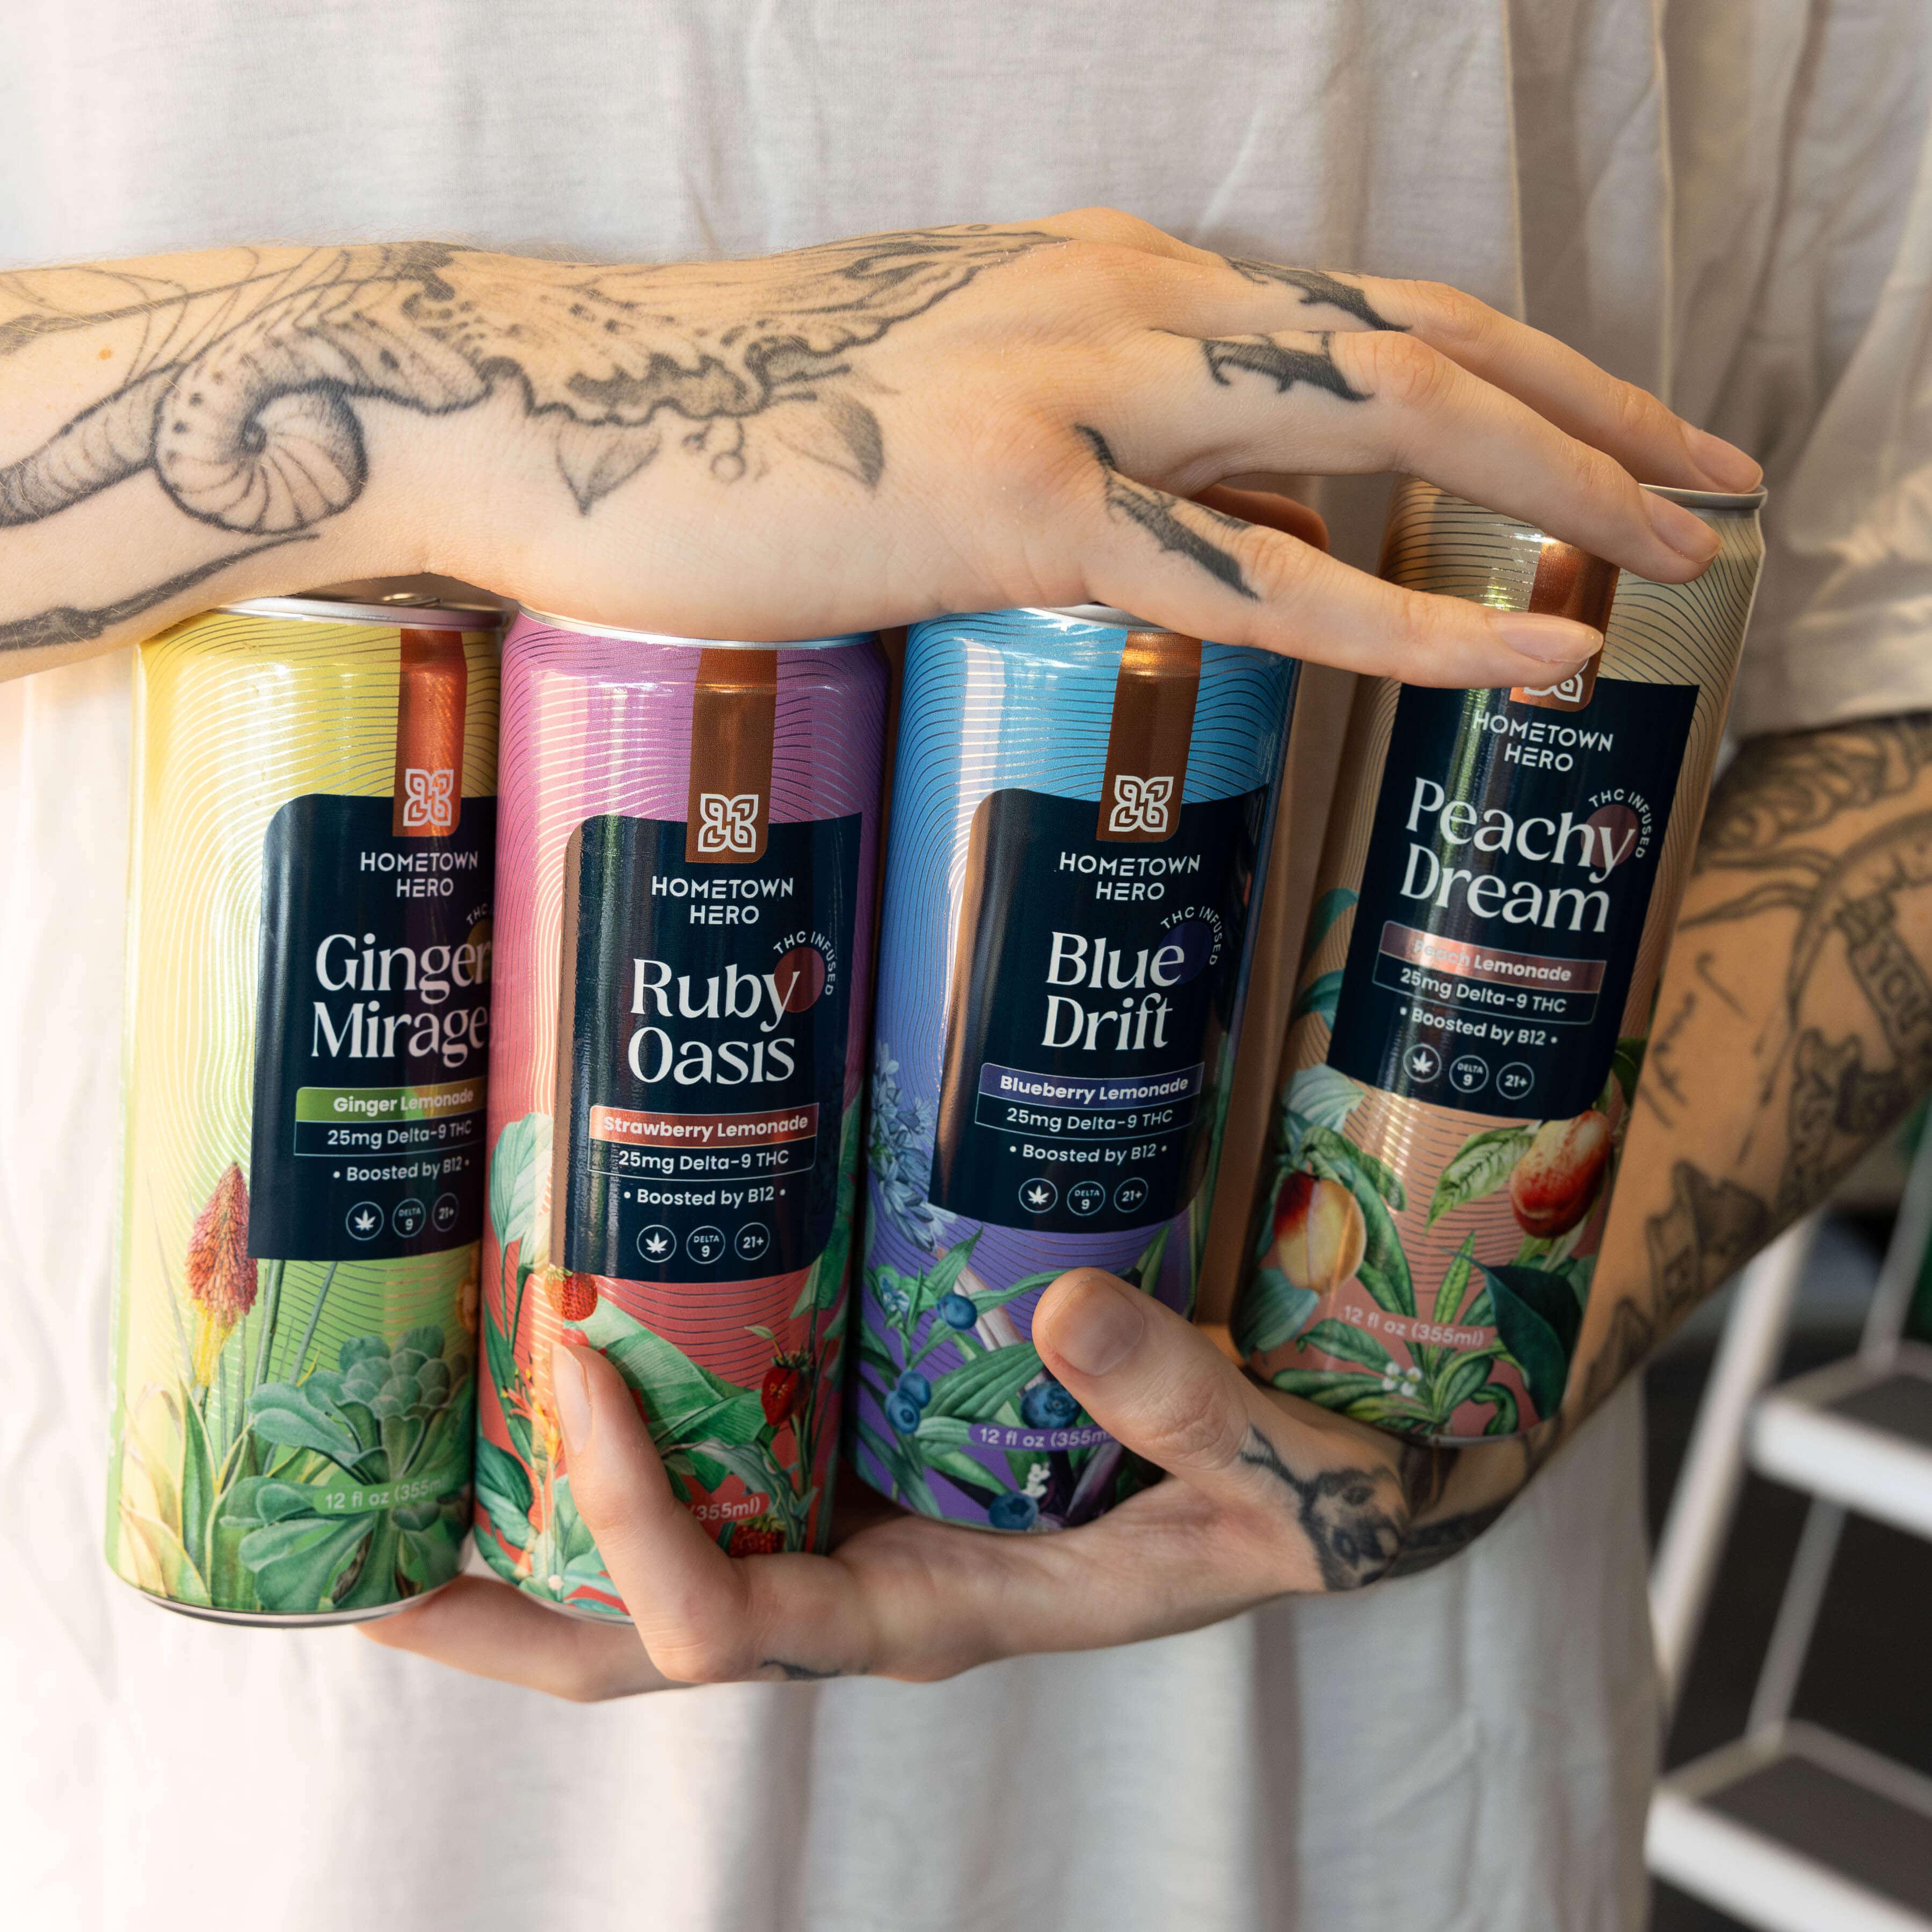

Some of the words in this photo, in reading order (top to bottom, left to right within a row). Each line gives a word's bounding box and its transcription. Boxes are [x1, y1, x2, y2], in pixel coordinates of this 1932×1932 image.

[1473, 709, 1614, 752] HOMETOWN
[1504, 743, 1574, 772] HERO
[1406, 777, 1636, 884] Peachy
[1588, 789, 1624, 807] THC
[1628, 791, 1652, 858] INFUSED
[360, 851, 478, 872] HOMETOWN
[1059, 852, 1201, 876] HOMETOWN
[397, 878, 454, 897] HERO
[652, 876, 793, 899] HOMETOWN
[1096, 881, 1165, 900] HERO
[1400, 842, 1610, 933] Dream
[466, 903, 488, 925] THC
[689, 905, 759, 925] HERO
[1160, 906, 1195, 929] THC
[1199, 906, 1222, 965] INFUSED
[316, 933, 492, 1004] Ginger
[773, 931, 806, 954] THC
[810, 931, 836, 996] INFUSED
[1045, 932, 1185, 989] Blue
[1413, 940, 1470, 967] Peach
[1475, 954, 1572, 982] Lemonade
[630, 958, 801, 1032] Ruby
[1400, 968, 1452, 999] 25mg
[1456, 984, 1528, 1009] Delta-9
[1532, 996, 1567, 1013] THC
[1041, 992, 1173, 1050] Drift
[1411, 1007, 1487, 1038] Boosted
[1491, 1023, 1514, 1045] by
[1517, 1029, 1546, 1046] B12
[311, 1000, 488, 1067] Mirage
[628, 1027, 795, 1085] Oasis
[1457, 1063, 1484, 1074] DELTA
[1463, 1074, 1473, 1087] 9
[1505, 1074, 1528, 1087] 21+
[1000, 1076, 1095, 1104] Blueberry
[1099, 1078, 1189, 1101] Lemonade
[333, 1096, 397, 1117] Ginger
[401, 1088, 474, 1110] Lemonade
[604, 1116, 713, 1142] Strawberry
[717, 1115, 808, 1138] Lemonade
[1006, 1108, 1062, 1132] 25mg
[1067, 1115, 1137, 1130] Delta-9
[1142, 1110, 1174, 1127] THC
[327, 1130, 382, 1149] 25mg
[387, 1124, 447, 1144] Delta-9
[449, 1120, 473, 1137] THC
[619, 1150, 674, 1174] 25mg
[680, 1153, 751, 1171] Delta-9
[756, 1150, 789, 1167] THC
[1023, 1144, 1100, 1163] Boosted
[1105, 1146, 1127, 1165] by
[1131, 1144, 1157, 1160] B12
[347, 1163, 418, 1181] Boosted
[422, 1160, 441, 1179] by
[443, 1156, 462, 1174] B12
[637, 1188, 716, 1205] Boosted
[721, 1189, 743, 1208] by
[748, 1186, 774, 1203] B12
[1081, 1199, 1090, 1210] 9
[1122, 1190, 1142, 1202] 21+
[398, 1207, 421, 1217] DELTA
[438, 1207, 455, 1220] 21+
[405, 1218, 413, 1231] 9
[693, 1235, 720, 1243] DELTA
[743, 1237, 764, 1248] 21+
[702, 1245, 710, 1258] 9
[1344, 1305, 1364, 1324] 12
[1367, 1311, 1380, 1329] fl
[1384, 1320, 1407, 1337] oz
[1412, 1321, 1485, 1346] (355ml)
[980, 1428, 1000, 1444] 12
[1005, 1430, 1018, 1446] fl
[1022, 1435, 1045, 1448] oz
[325, 1492, 345, 1509] 12
[352, 1491, 363, 1507] fl
[369, 1491, 390, 1505] oz
